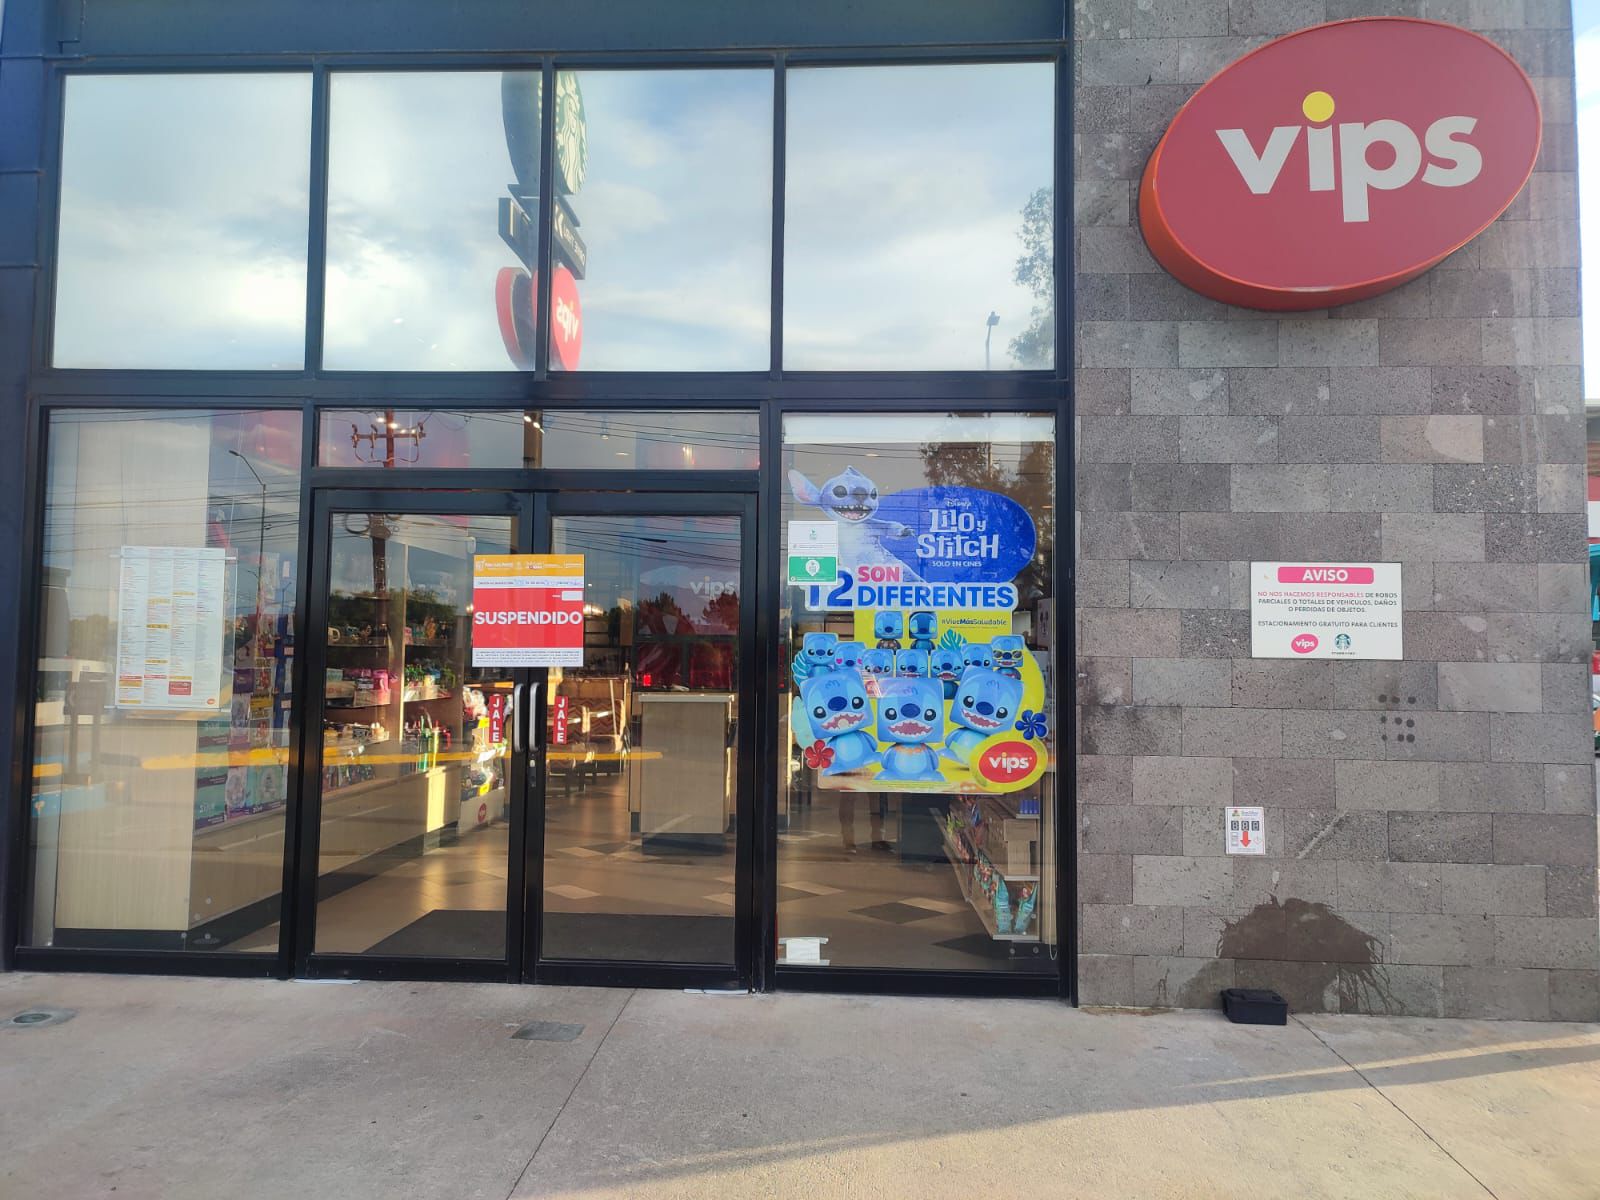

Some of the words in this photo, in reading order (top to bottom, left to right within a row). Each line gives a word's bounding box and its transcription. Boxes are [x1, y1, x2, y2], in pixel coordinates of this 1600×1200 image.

[1215, 91, 1483, 223] vips
[976, 519, 987, 532] y
[858, 565, 901, 582] SON
[1302, 569, 1349, 582] AVISO
[689, 576, 736, 601] vips
[858, 585, 1015, 608] DIFERENTES
[1374, 598, 1398, 606] DAÑOS
[474, 611, 583, 625] SUSPENDIDO
[1295, 639, 1315, 649] vips
[492, 697, 501, 742] JALE
[556, 698, 566, 743] JALE
[988, 752, 1030, 773] vips
